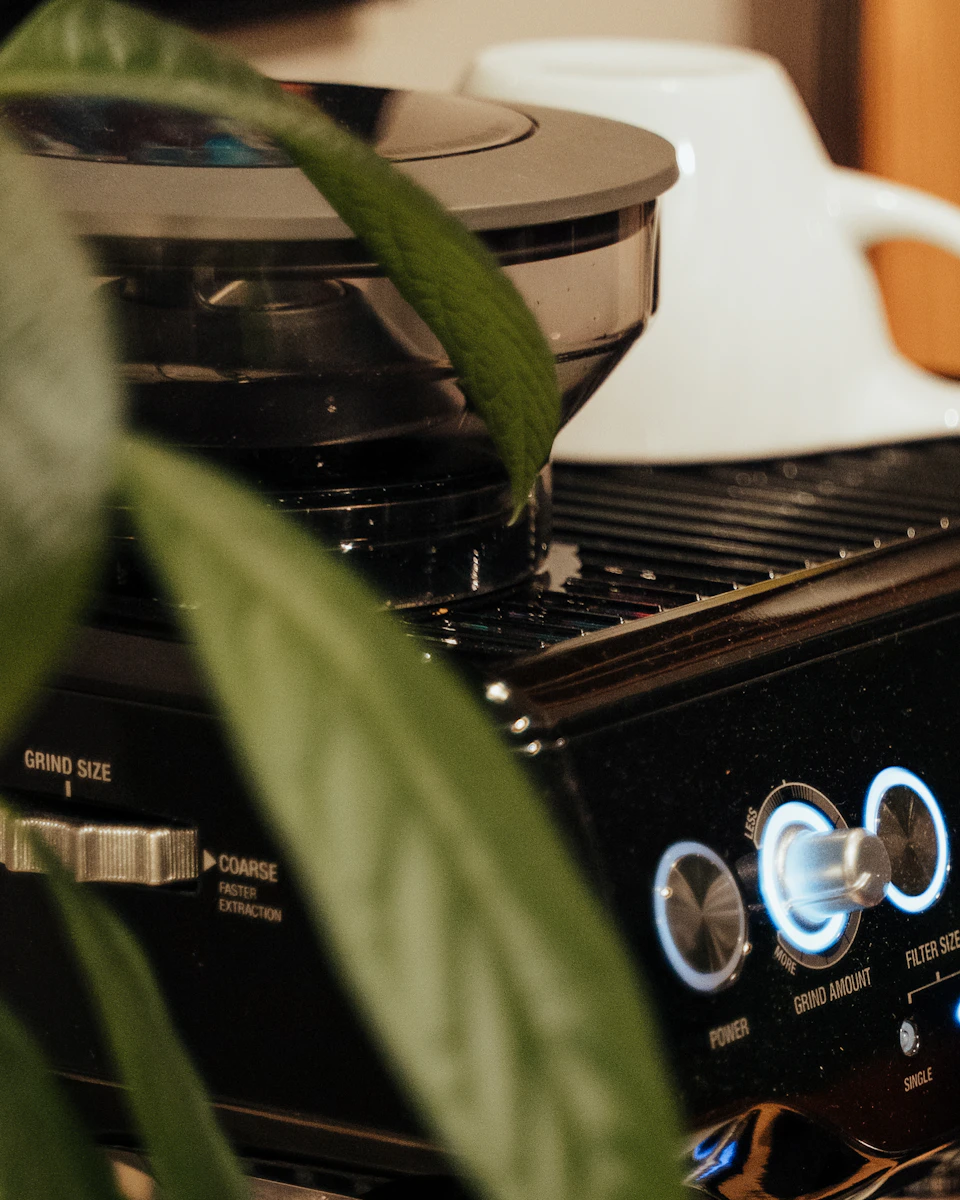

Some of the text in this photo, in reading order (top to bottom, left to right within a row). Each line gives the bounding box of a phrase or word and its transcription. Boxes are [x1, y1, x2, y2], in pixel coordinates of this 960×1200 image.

[24, 750, 112, 783] GRIND SIZE
[744, 806, 758, 840] LESS
[218, 854, 278, 882] COARSE
[218, 881, 257, 899] FASTER
[218, 898, 282, 923] EXTRACTION
[773, 945, 797, 976] MORE
[905, 939, 939, 969] FILTER
[793, 967, 871, 1015] GRIND AMOUNT
[709, 1017, 750, 1049] POWER
[903, 1066, 933, 1092] SINGLE
